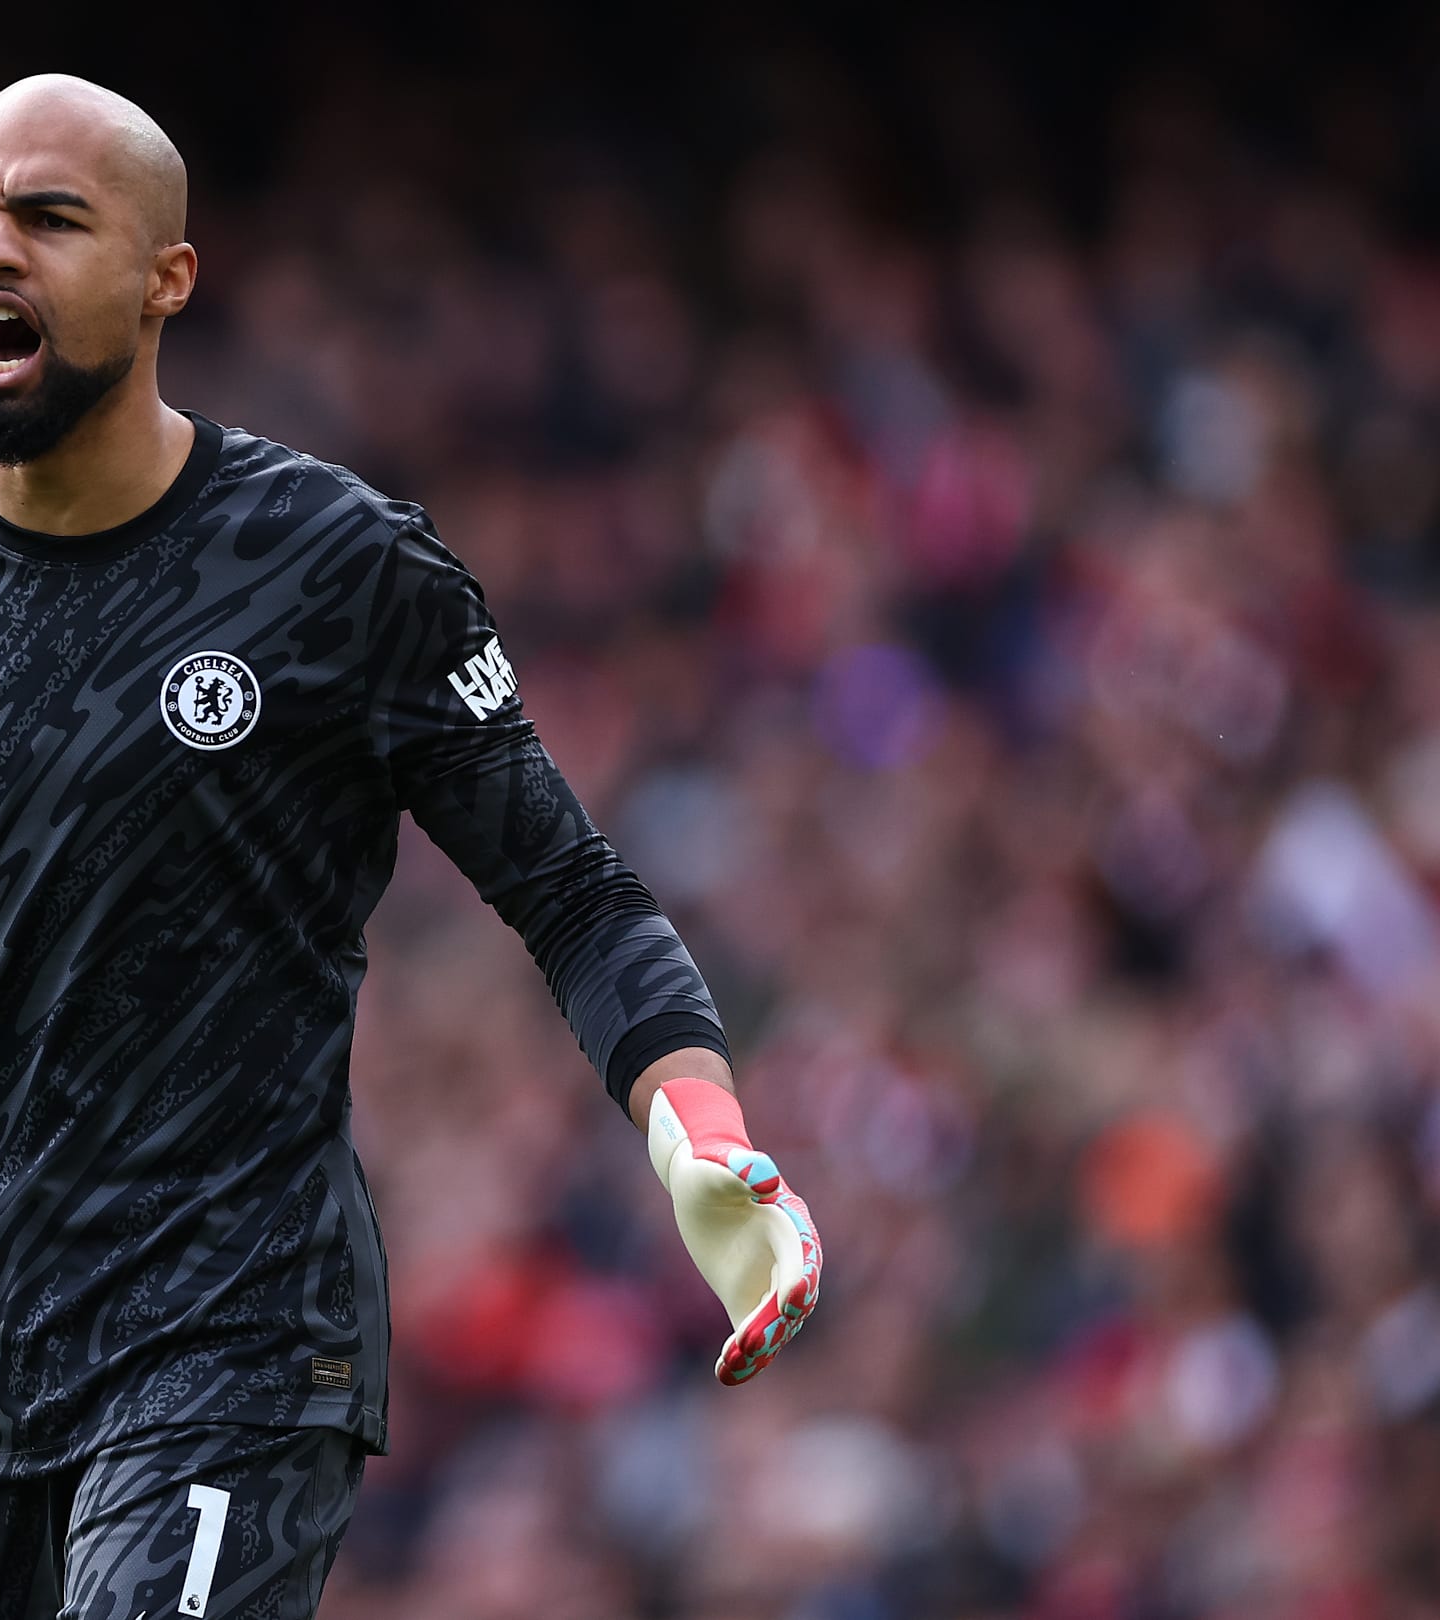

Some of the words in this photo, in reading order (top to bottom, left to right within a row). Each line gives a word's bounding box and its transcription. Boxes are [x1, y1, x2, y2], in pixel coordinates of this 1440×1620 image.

[183, 659, 244, 681] CHELSEA
[447, 635, 505, 699] LIVE
[176, 721, 215, 743] FOOTBALL
[219, 728, 239, 742] CLUB
[177, 1483, 231, 1619] 1
